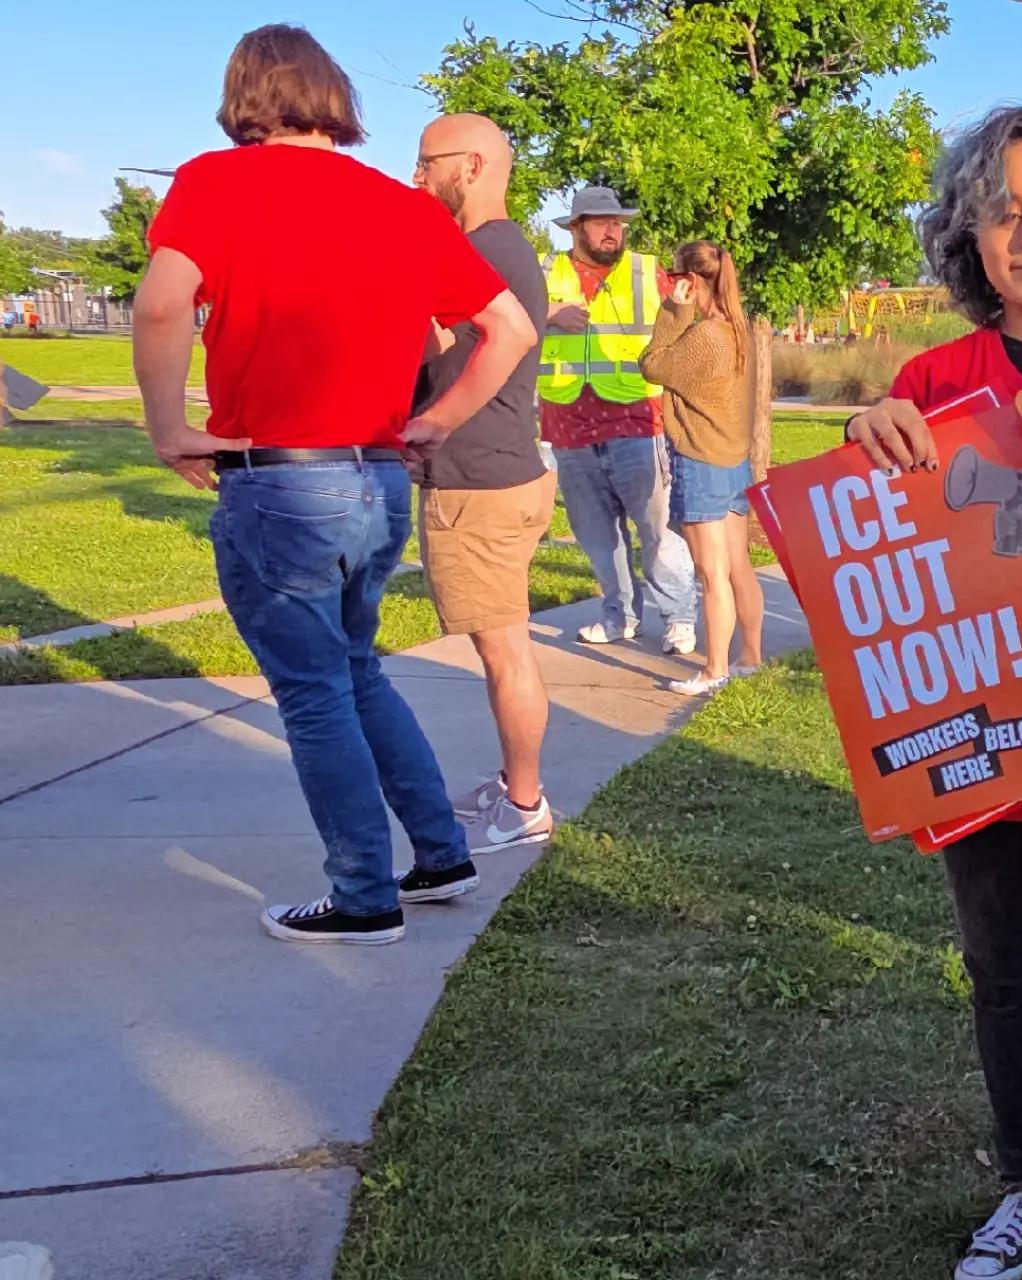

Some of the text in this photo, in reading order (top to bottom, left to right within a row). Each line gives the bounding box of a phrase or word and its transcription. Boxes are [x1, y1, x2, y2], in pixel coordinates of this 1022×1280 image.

[809, 464, 918, 559] ICE
[833, 538, 956, 637] OUT
[884, 713, 980, 770] WORKERS
[940, 753, 994, 791] HERE
